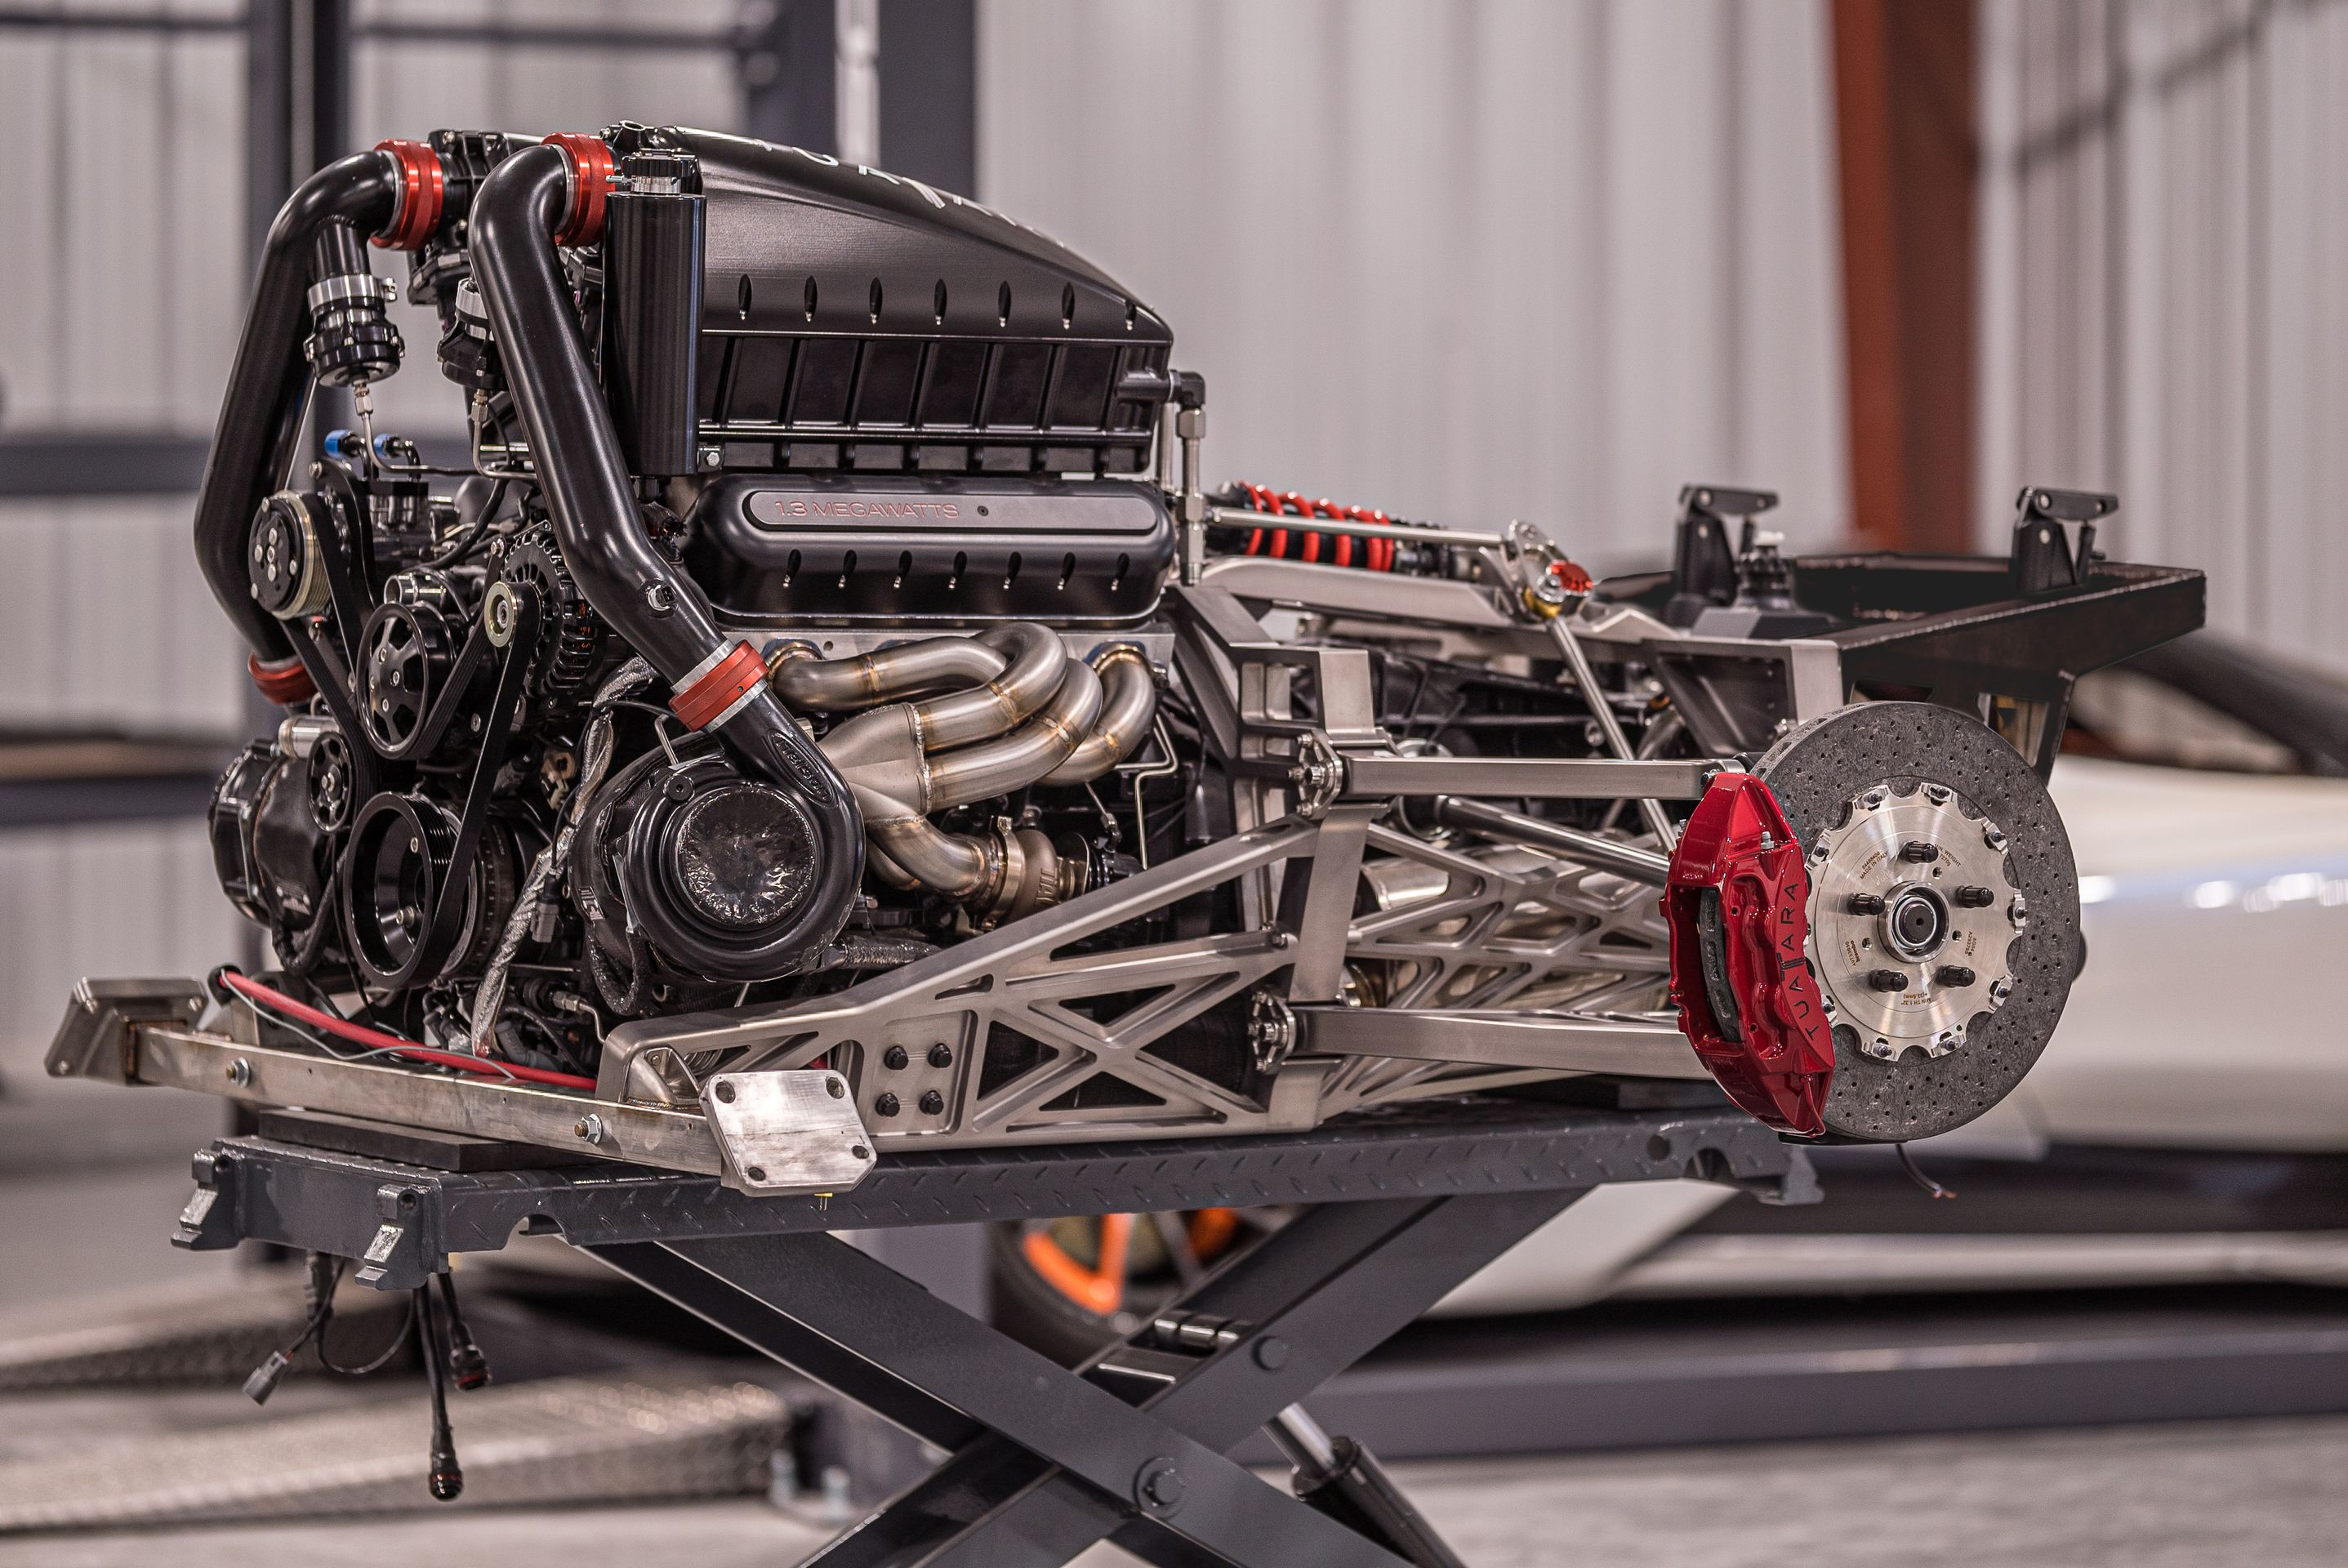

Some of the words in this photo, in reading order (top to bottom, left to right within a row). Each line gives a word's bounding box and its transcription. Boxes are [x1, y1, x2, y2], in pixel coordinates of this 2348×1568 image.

[775, 501, 808, 517] 1.3
[813, 501, 960, 519] MEGAWATTS
[1860, 866, 1872, 880] MADE
[1877, 851, 1888, 862] ITALY
[1945, 850, 1962, 867] WEIGHT
[1775, 882, 1820, 1041] TUATARA
[1851, 940, 1860, 962] brembo
